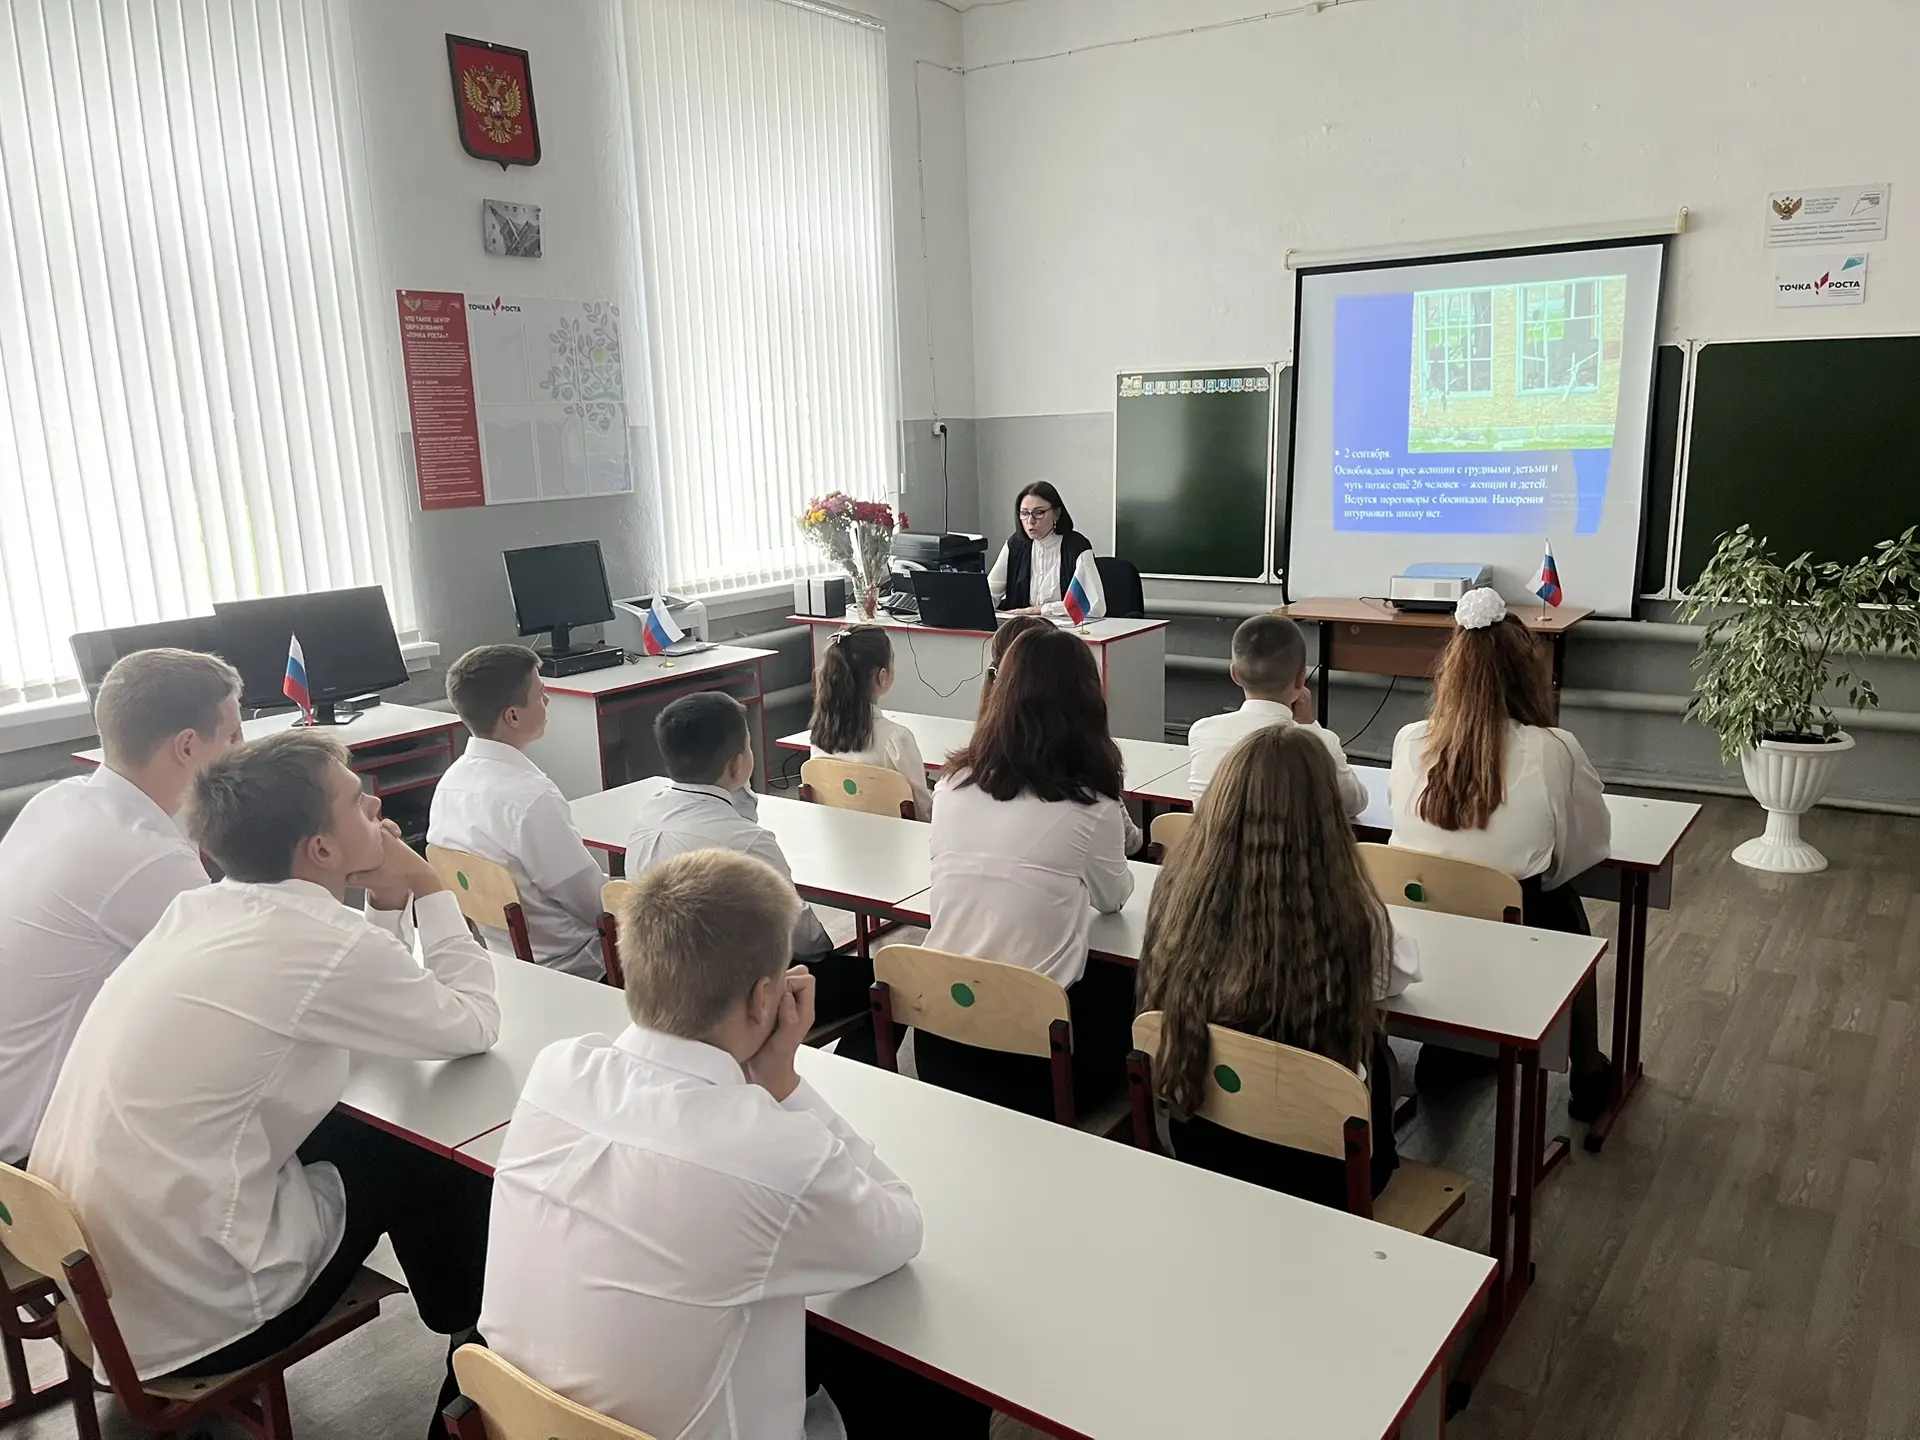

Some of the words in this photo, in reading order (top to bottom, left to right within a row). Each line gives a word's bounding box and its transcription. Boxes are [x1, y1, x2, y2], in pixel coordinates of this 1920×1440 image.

[1779, 283, 1812, 291] ТОЧКА
[468, 303, 491, 311] ТОЧКА
[1344, 448, 1350, 459] 2
[1334, 465, 1394, 476] Освобождены
[1397, 467, 1416, 477] трое
[1418, 466, 1455, 475] женщин
[1456, 466, 1463, 474] с
[1464, 466, 1511, 477] грудными
[1512, 464, 1549, 475] детьми
[1551, 464, 1558, 473] и
[1344, 482, 1363, 491] чуть
[1365, 482, 1391, 490] позже
[1392, 480, 1410, 490] ещё
[1411, 479, 1423, 489] 26
[1424, 481, 1460, 489] человек
[1469, 481, 1508, 490] женщин
[1510, 481, 1517, 489] и
[1518, 479, 1548, 489] детей.
[1344, 494, 1377, 505] Ведутся
[1380, 496, 1430, 506] переговоры
[1431, 496, 1438, 504] с
[1439, 493, 1489, 504] боевиками.
[1492, 494, 1544, 506] Намерения
[1344, 510, 1394, 520] штурмовать
[1396, 510, 1424, 520] школу
[1426, 510, 1443, 518] нет.
